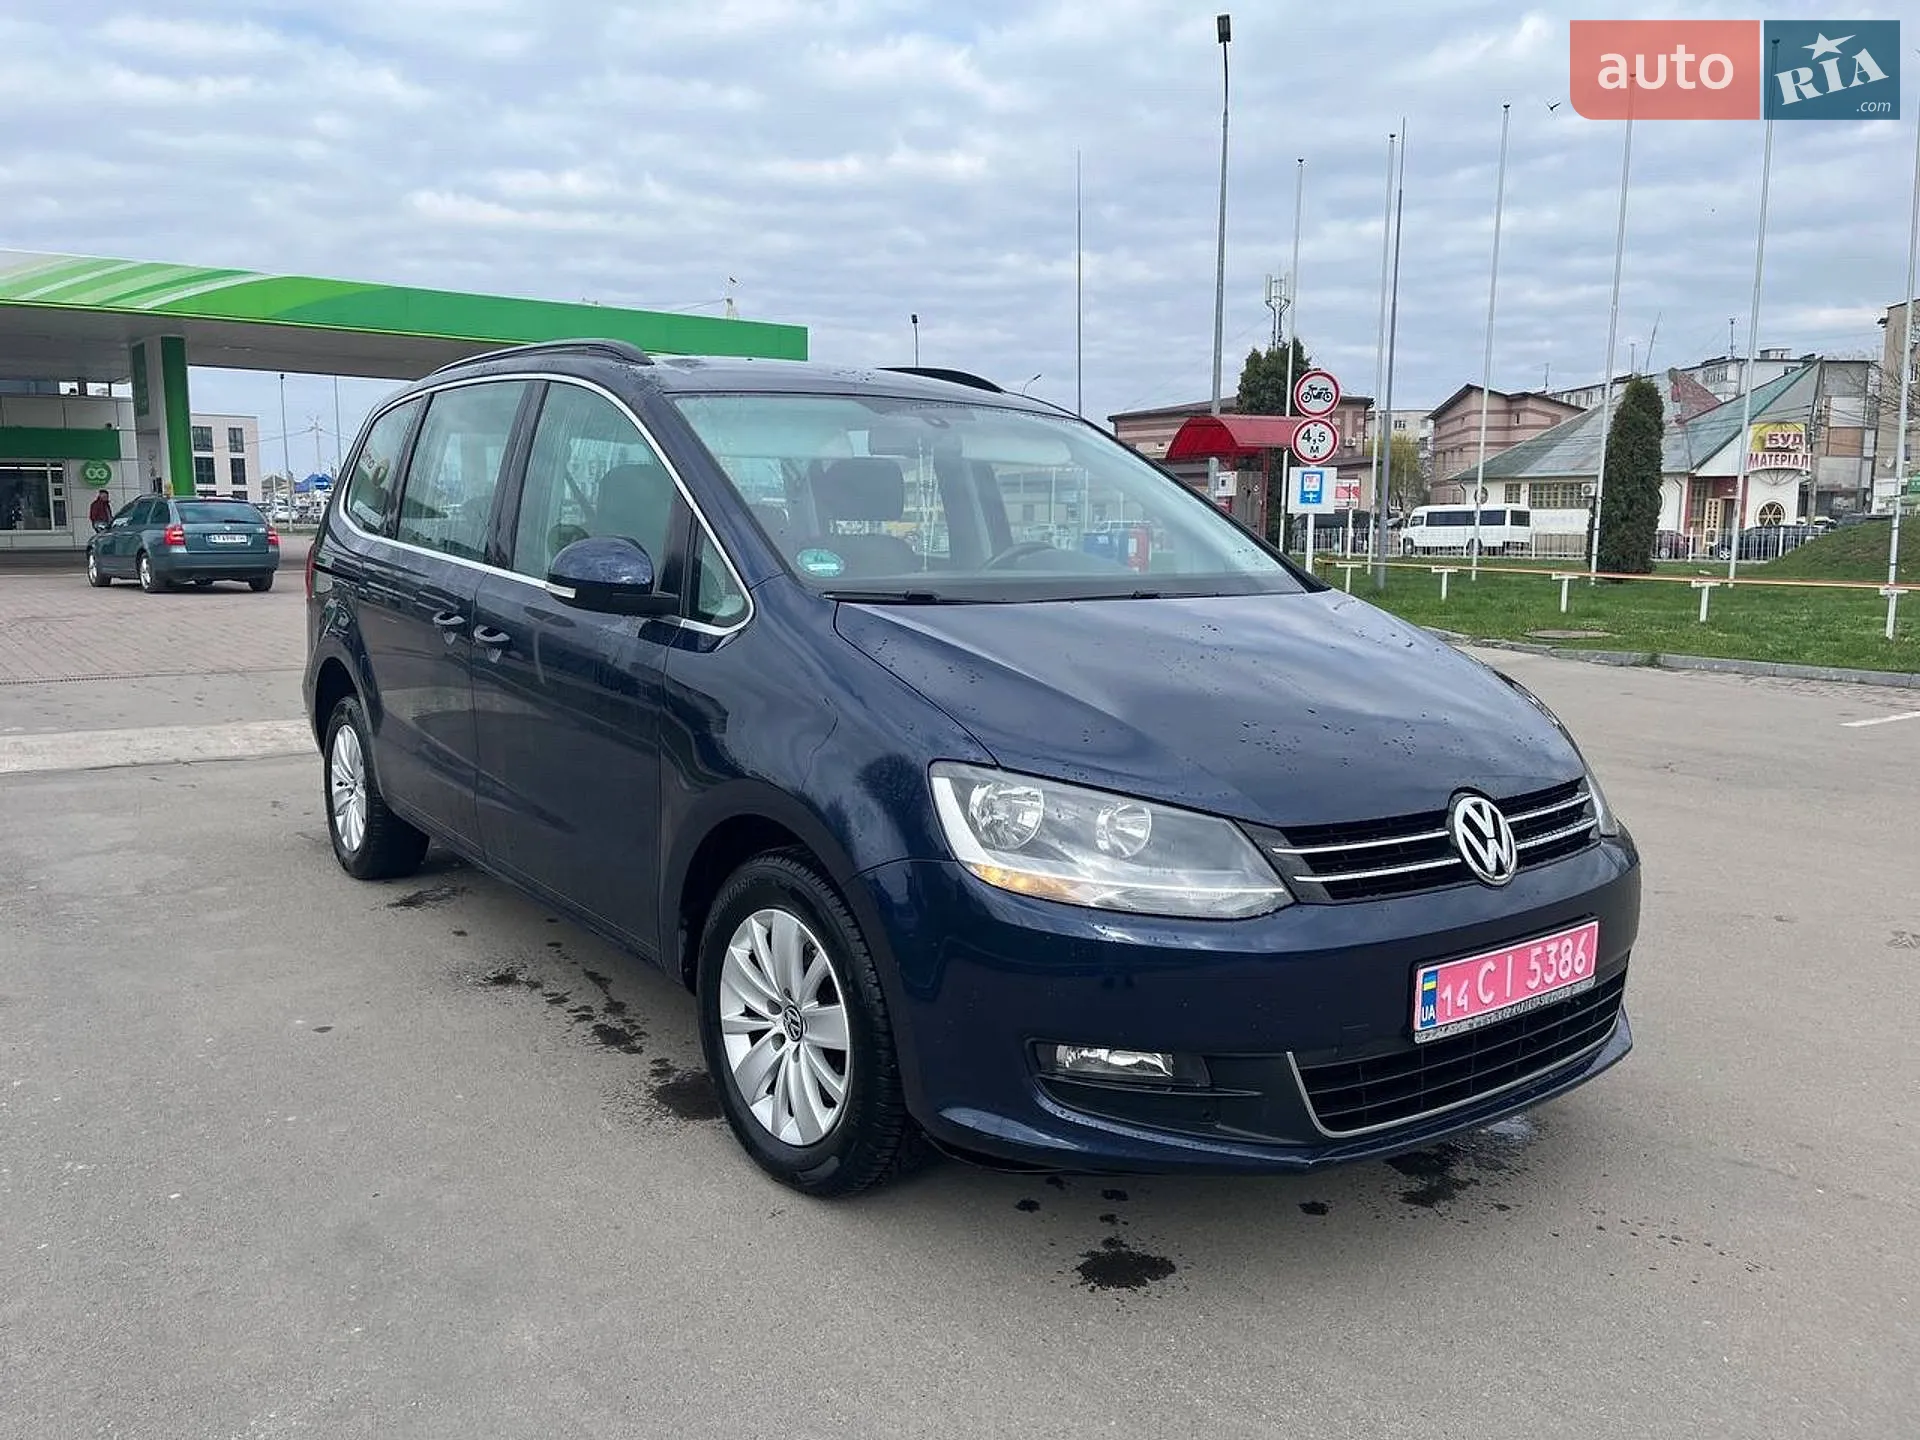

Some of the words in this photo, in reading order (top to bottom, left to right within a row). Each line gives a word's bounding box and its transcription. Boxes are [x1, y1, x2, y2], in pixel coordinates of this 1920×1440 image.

[1302, 428, 1326, 445] 4,5
[1767, 432, 1804, 447] БУД
[1441, 979, 1471, 1016] 14
[1526, 932, 1588, 989] 5386
[1422, 1004, 1436, 1022] UA
